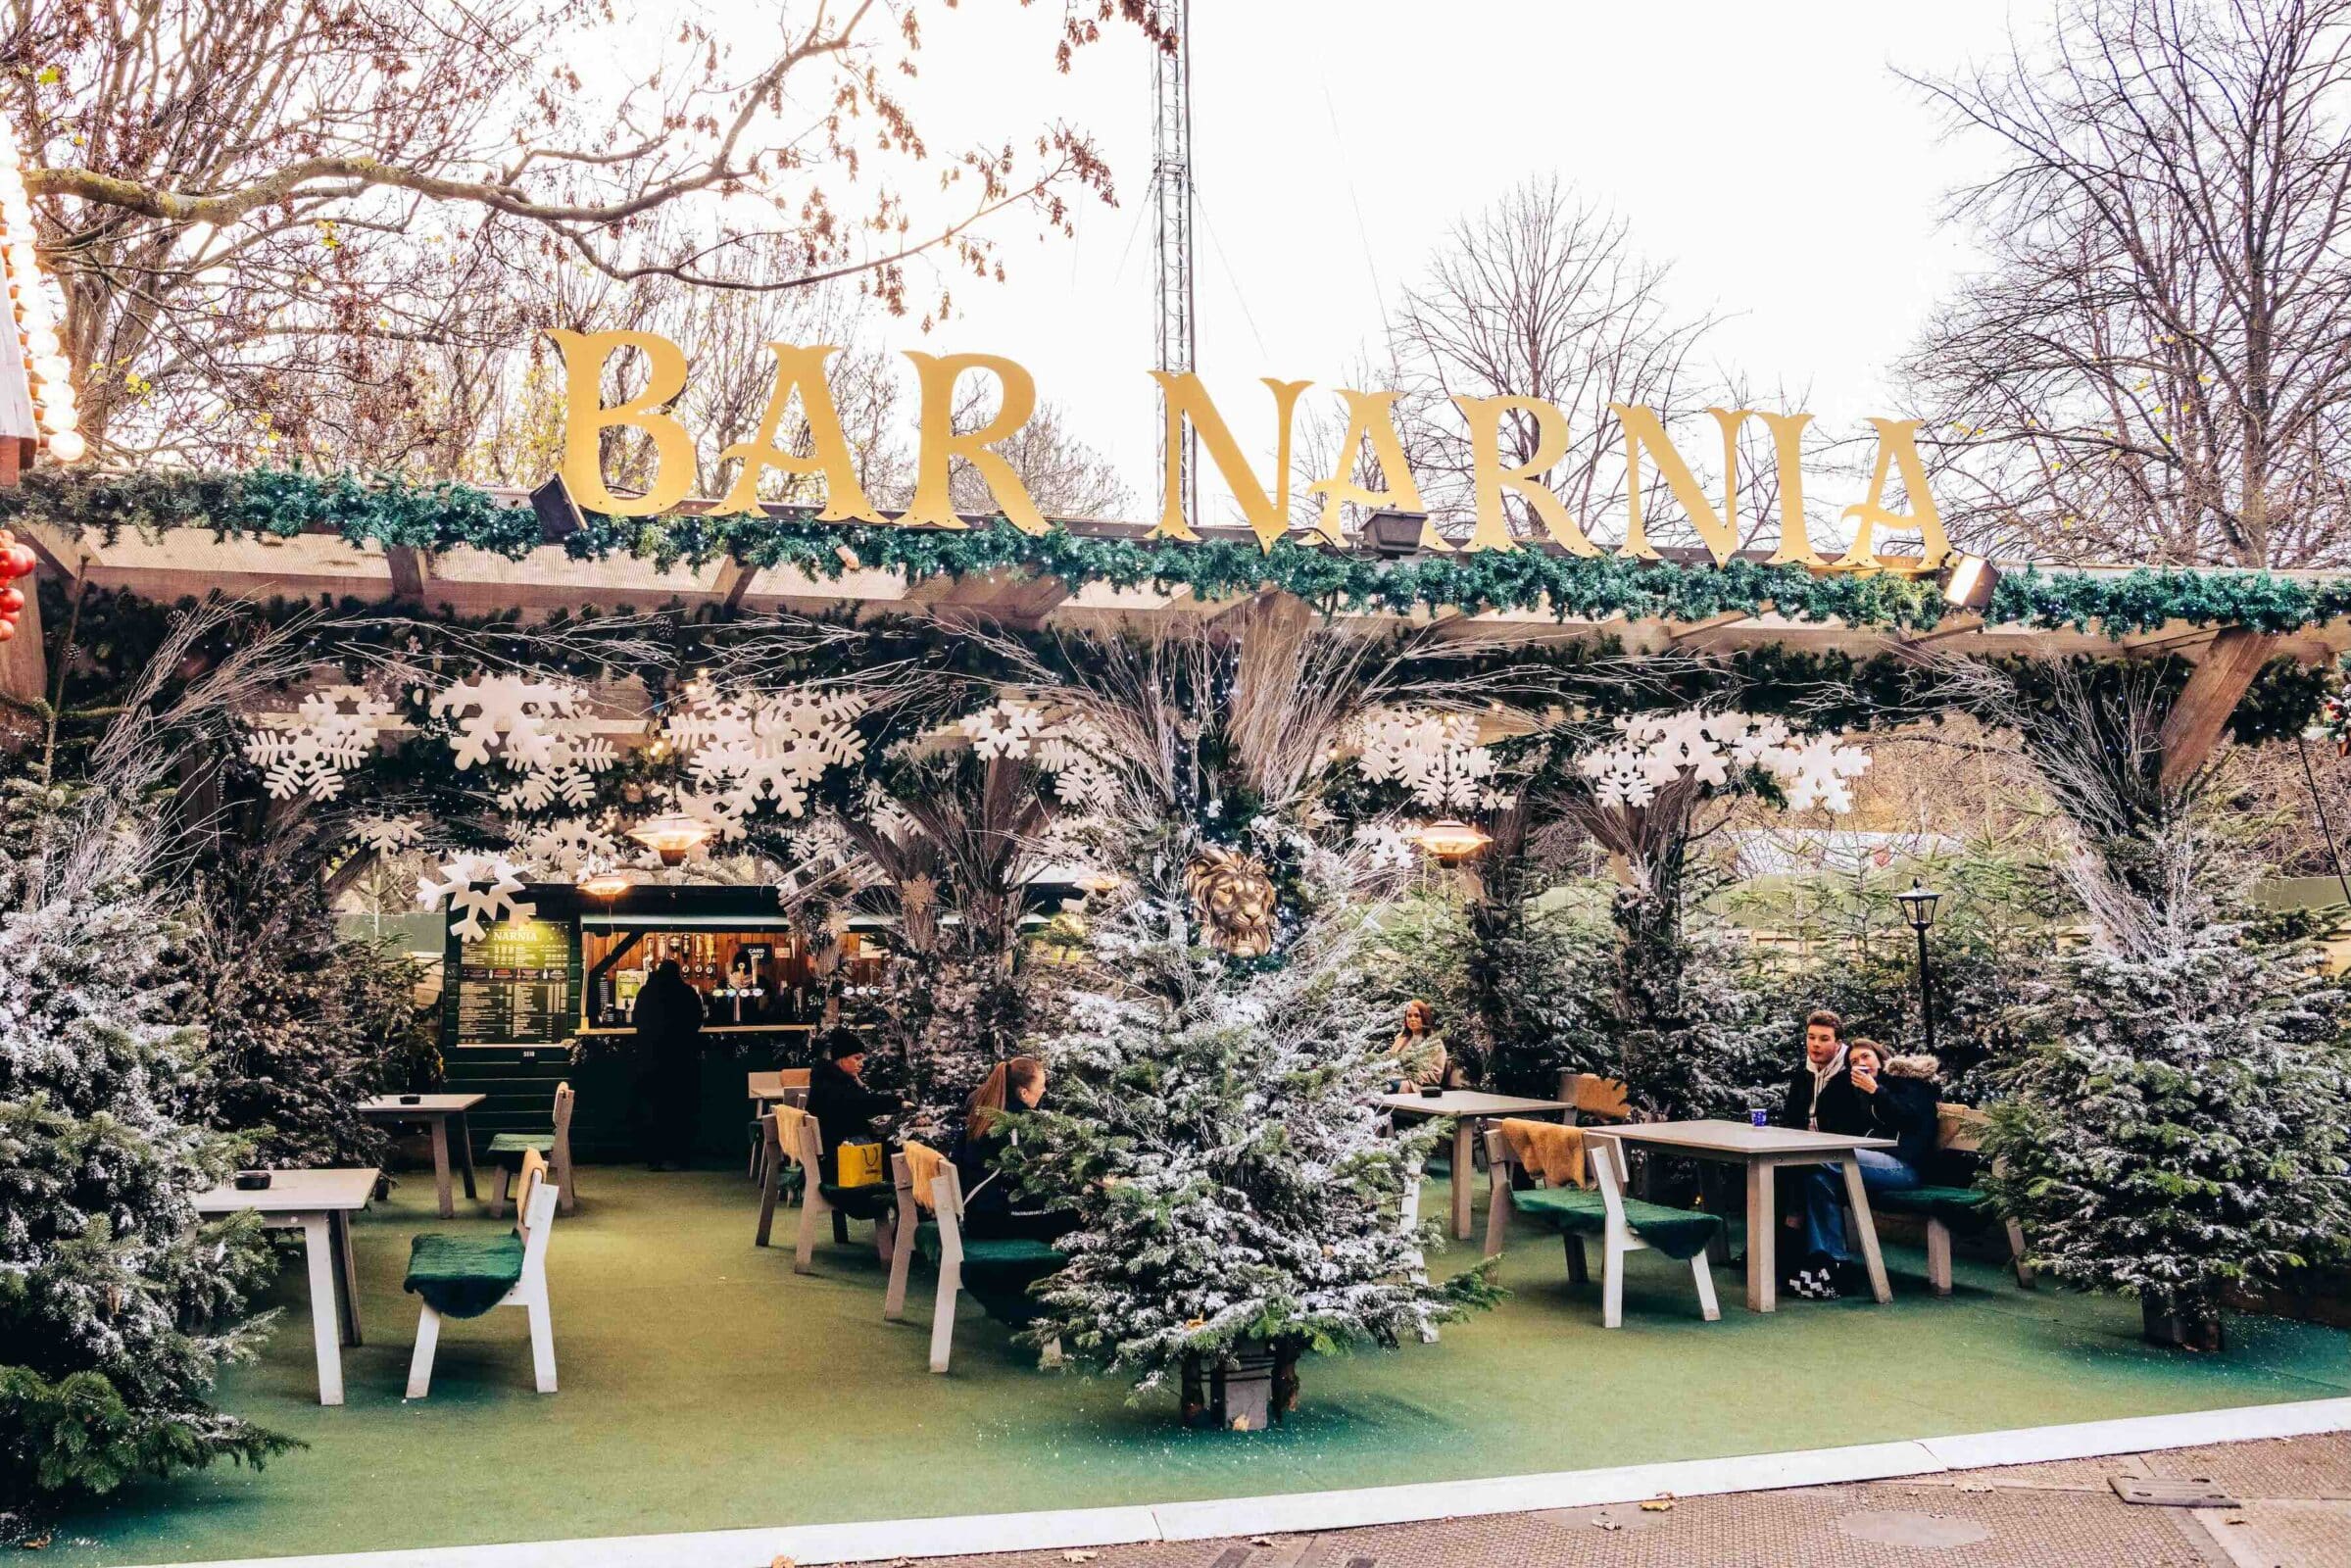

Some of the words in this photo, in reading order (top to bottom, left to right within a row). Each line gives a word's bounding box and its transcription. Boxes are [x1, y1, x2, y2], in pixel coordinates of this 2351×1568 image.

[545, 328, 1053, 535] BAR
[1144, 369, 1951, 569] NARNIA
[493, 931, 538, 942] NARNIA
